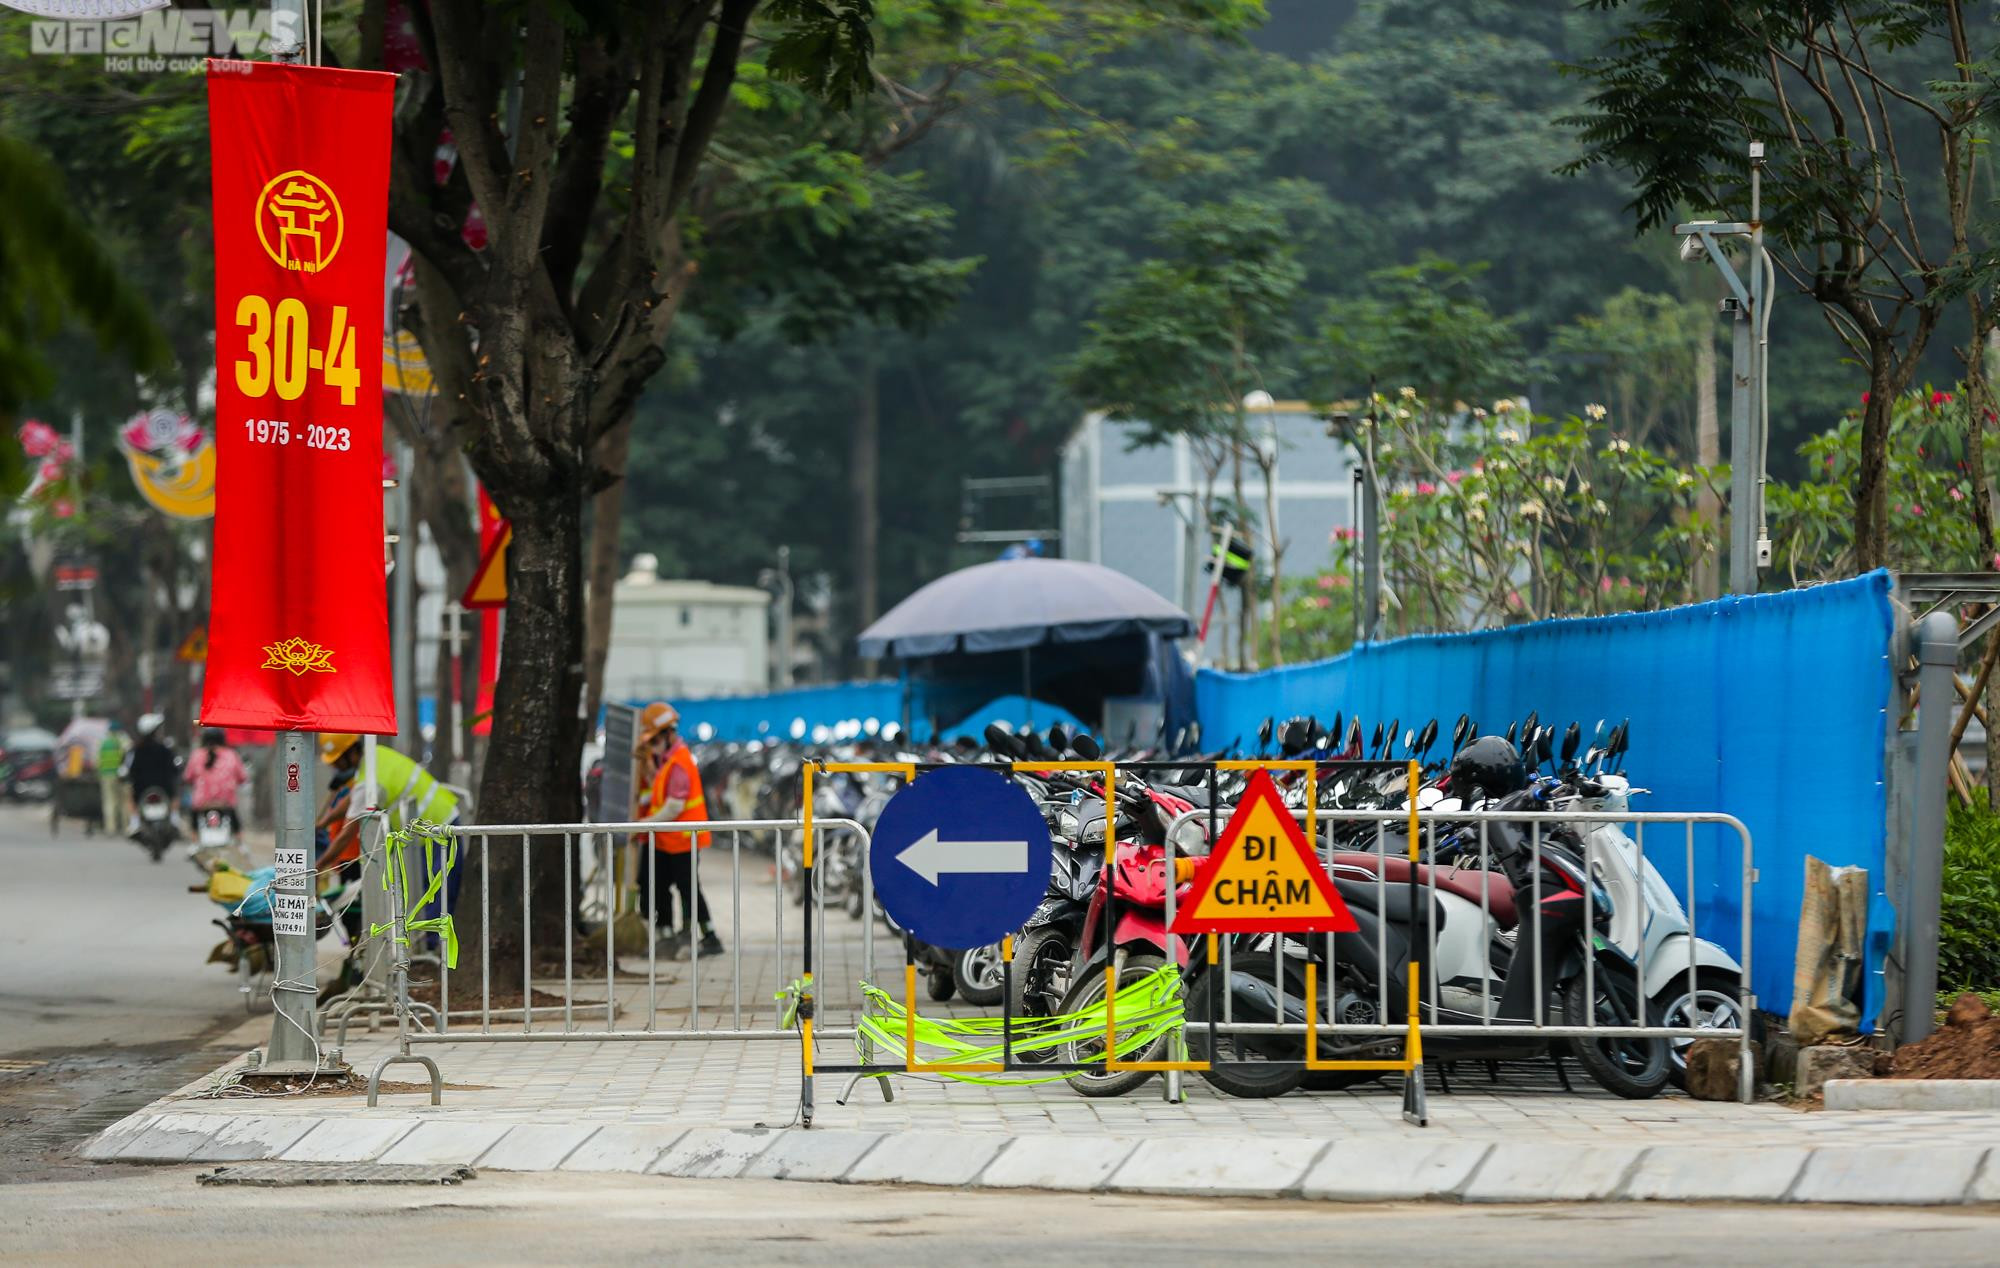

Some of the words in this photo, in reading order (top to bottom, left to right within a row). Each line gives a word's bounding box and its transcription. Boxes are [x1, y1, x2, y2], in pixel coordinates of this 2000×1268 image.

[288, 258, 301, 271] HÀ
[235, 295, 360, 406] 30-4
[245, 418, 290, 445] 1975
[307, 424, 351, 451] 2023
[286, 853, 303, 864] XE
[1242, 835, 1276, 862] ĐI
[1214, 870, 1311, 912] CHẬM
[277, 897, 286, 909] XE
[287, 896, 306, 910] MÁY
[290, 911, 304, 920] 24H
